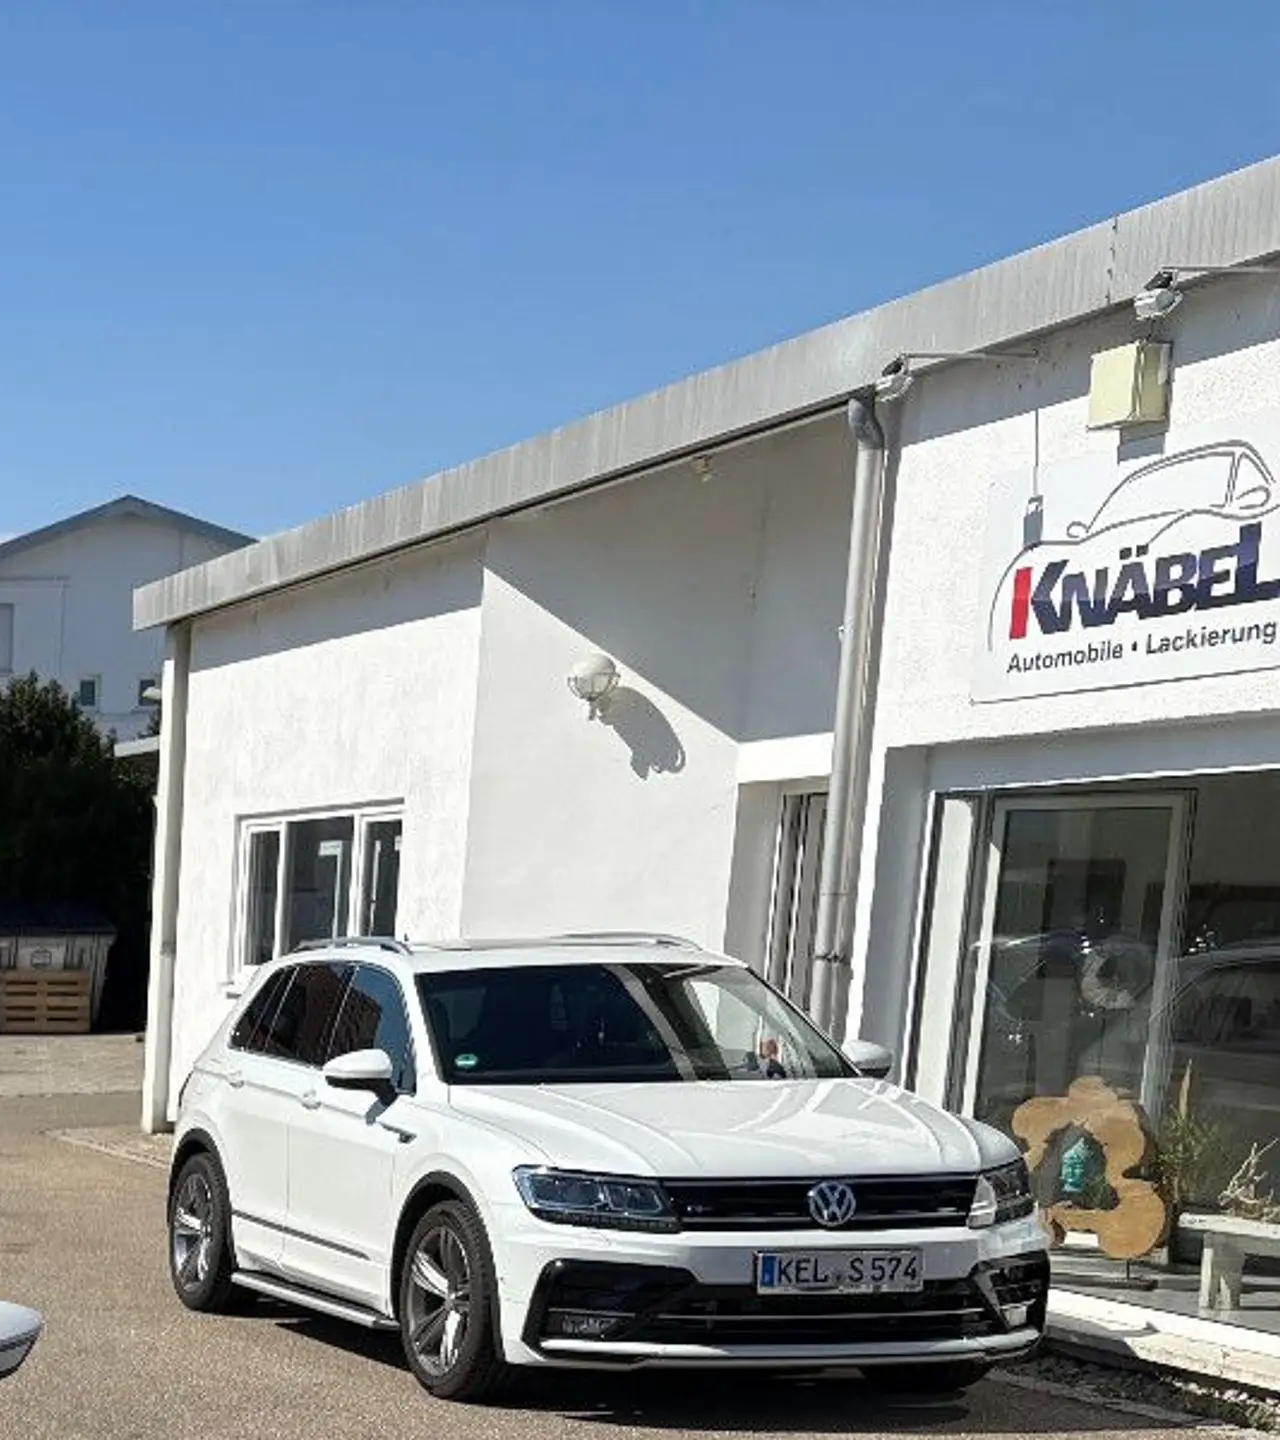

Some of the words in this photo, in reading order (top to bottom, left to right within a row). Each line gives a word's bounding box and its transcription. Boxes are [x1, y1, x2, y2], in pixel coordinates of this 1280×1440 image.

[1009, 521, 1280, 640] KNÄBEL
[1007, 641, 1124, 674] Automobile
[1146, 621, 1278, 655] Lackierung
[777, 1258, 829, 1284] KEL
[848, 1257, 865, 1283] S
[870, 1256, 918, 1282] 574
